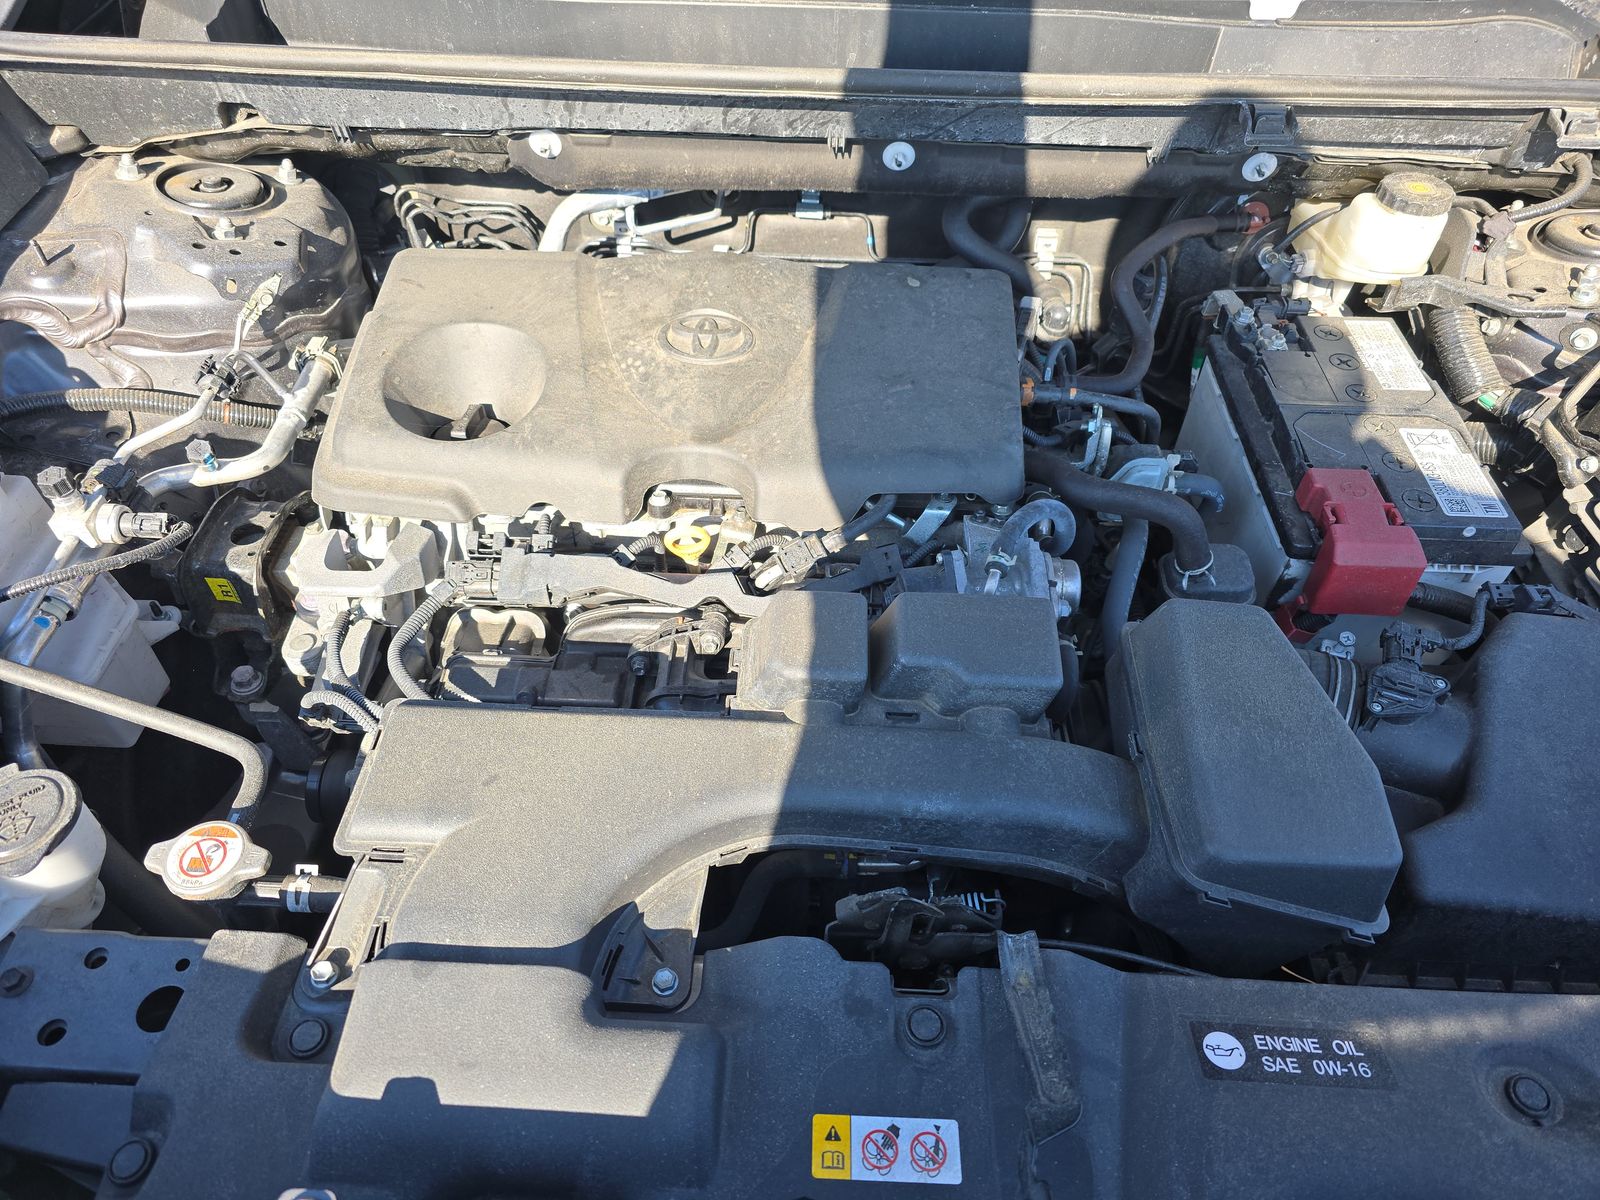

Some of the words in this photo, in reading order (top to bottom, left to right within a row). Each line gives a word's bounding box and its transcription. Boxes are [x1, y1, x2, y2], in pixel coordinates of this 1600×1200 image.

[1481, 503, 1500, 513] TM
[1253, 1034, 1322, 1054] ENGINE
[1332, 1039, 1364, 1057] OIL
[1261, 1056, 1301, 1074] SAE
[1313, 1060, 1372, 1078] 0W-16
